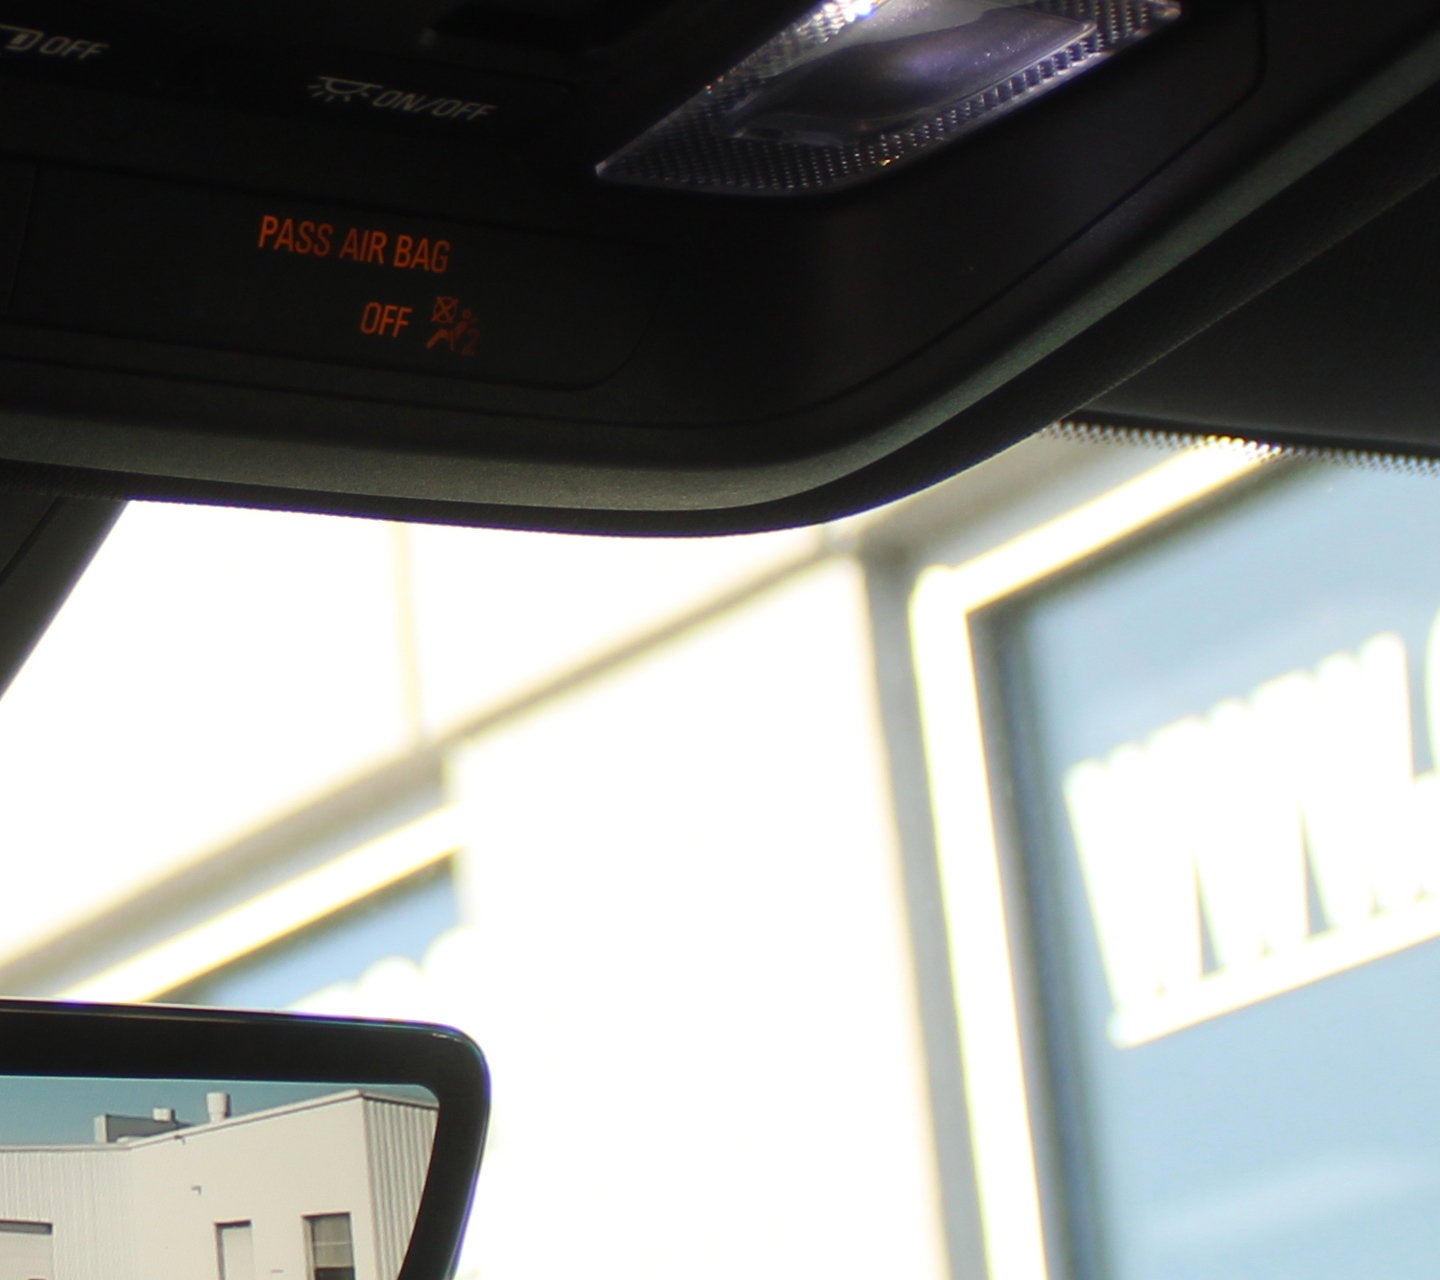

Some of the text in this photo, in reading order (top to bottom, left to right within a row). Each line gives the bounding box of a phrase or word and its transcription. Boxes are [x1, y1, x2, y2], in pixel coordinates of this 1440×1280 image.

[39, 34, 113, 61] OFF
[371, 88, 500, 122] ON/OFF
[257, 214, 452, 274] PASS AIR BAG
[359, 301, 414, 339] OFF
